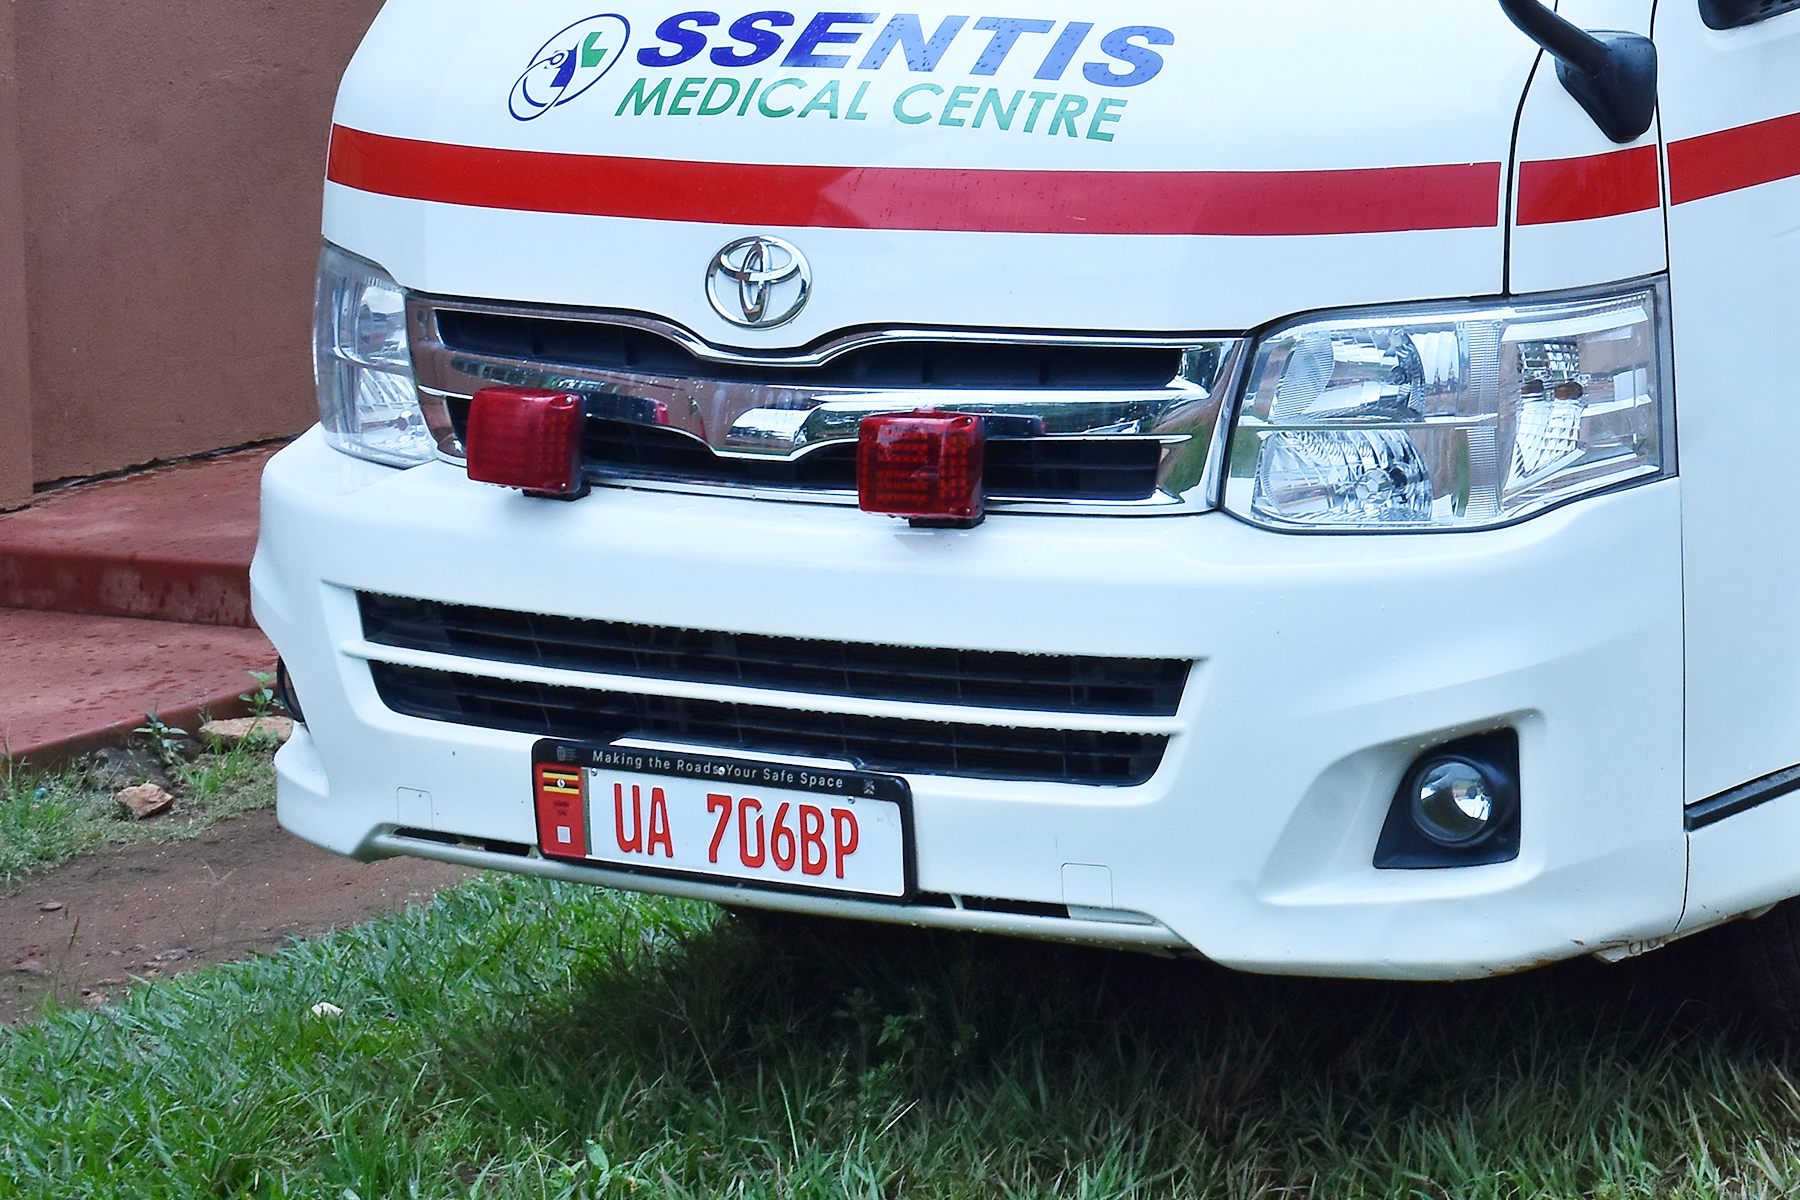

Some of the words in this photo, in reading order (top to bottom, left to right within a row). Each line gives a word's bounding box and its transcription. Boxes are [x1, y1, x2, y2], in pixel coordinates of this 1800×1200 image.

[636, 10, 1175, 88] SSENTIS
[614, 76, 870, 121] MEDICAL
[893, 82, 1129, 142] CENTRE
[592, 750, 643, 769] Making
[649, 756, 671, 770] the
[676, 759, 720, 775] Roads
[726, 764, 758, 778] Your
[763, 768, 794, 783] Safe
[800, 772, 844, 789] Space
[614, 782, 674, 858] UA
[706, 793, 859, 880] 706BP
